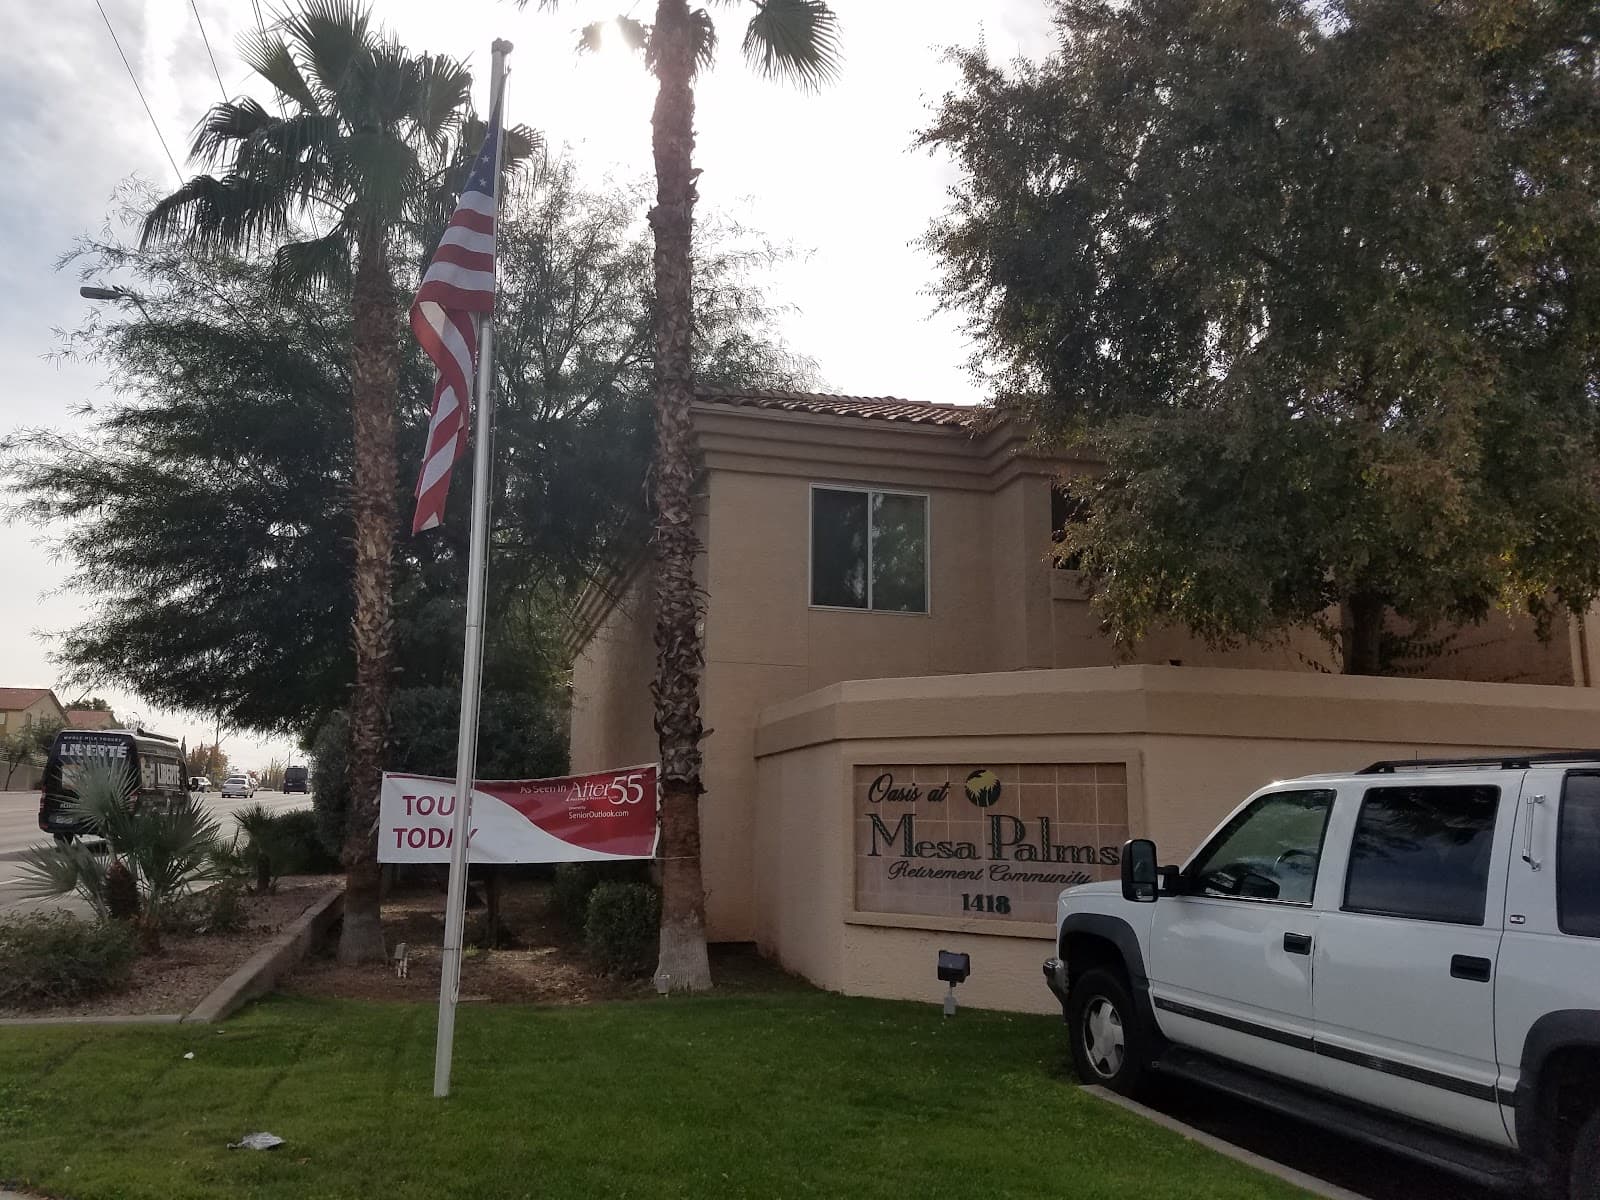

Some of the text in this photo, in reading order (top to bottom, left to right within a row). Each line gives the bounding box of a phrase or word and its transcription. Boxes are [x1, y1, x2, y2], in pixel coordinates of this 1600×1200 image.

[532, 785, 556, 794] Seen
[868, 773, 951, 803] Oasis at
[402, 795, 472, 817] TOU
[568, 809, 630, 820] SeniorOutlook.com
[865, 813, 1120, 865] Mesa Palms
[888, 861, 1091, 884] Retirement Community
[961, 893, 1011, 914] 1418
